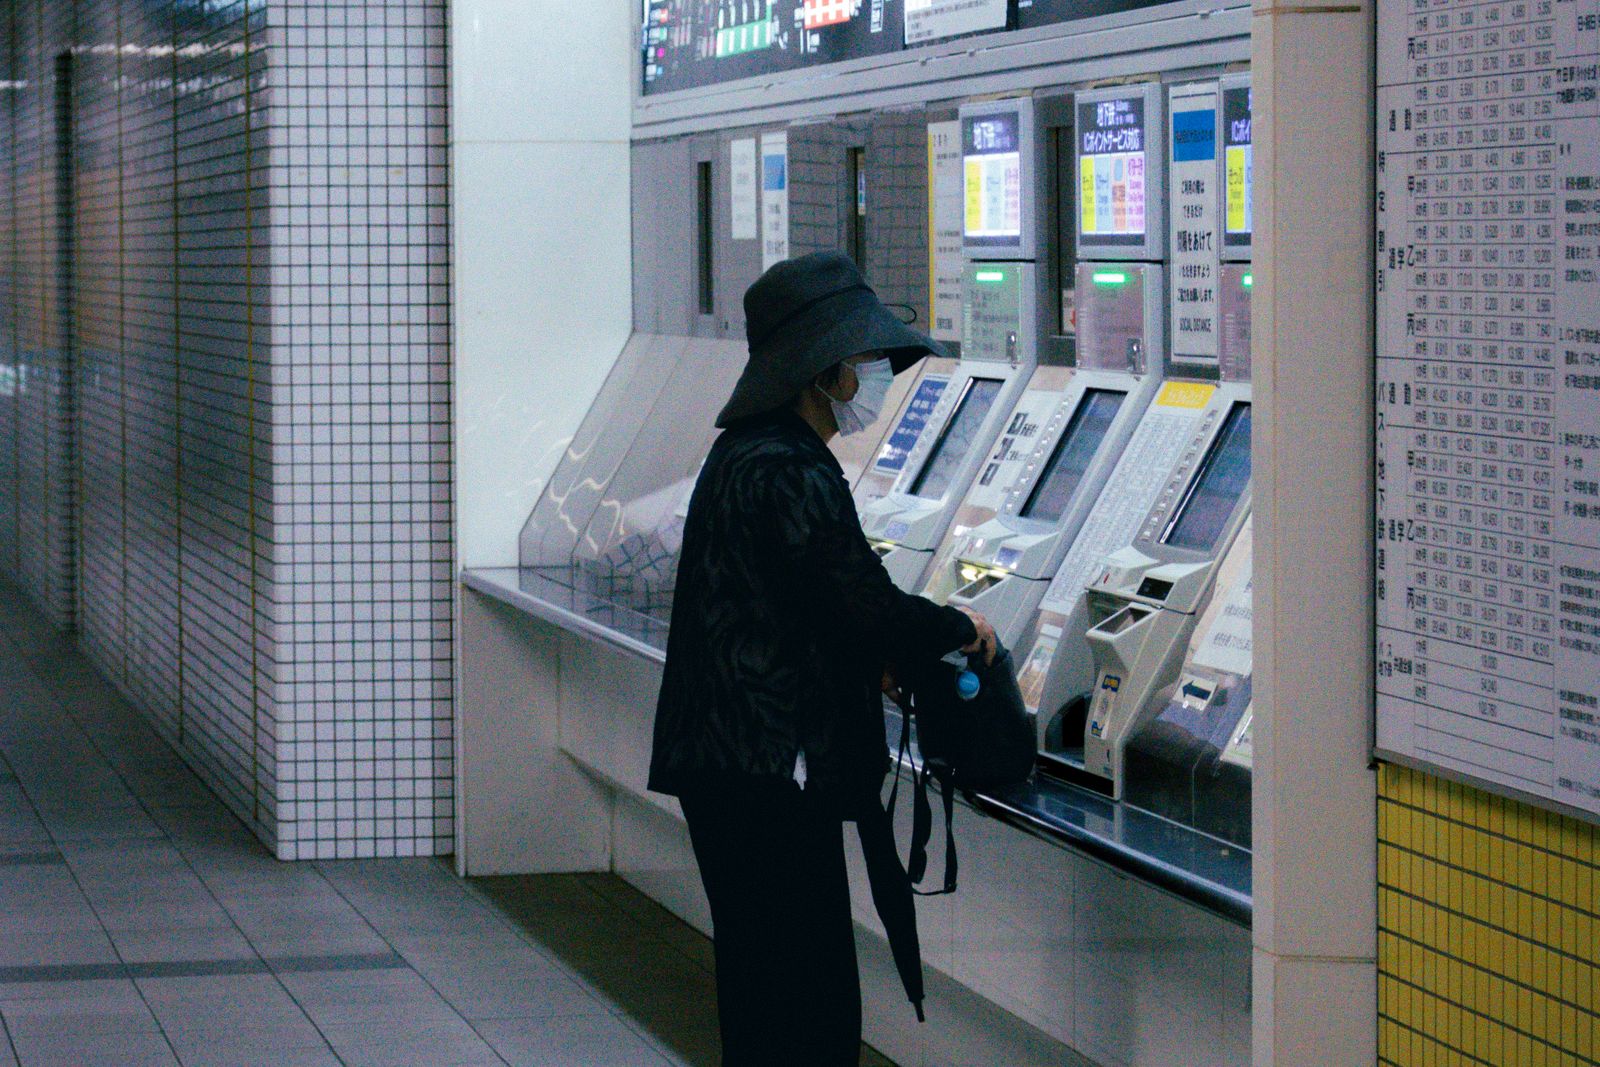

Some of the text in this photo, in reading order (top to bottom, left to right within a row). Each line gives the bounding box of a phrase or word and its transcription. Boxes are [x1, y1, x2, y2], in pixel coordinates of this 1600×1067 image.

[1097, 102, 1115, 127] 地下鉄
[1183, 205, 1203, 219] できるだけ
[1177, 230, 1212, 252] 間隔をあけて
[1178, 264, 1211, 278] いただきますよう
[1193, 318, 1212, 333] DISTANCE
